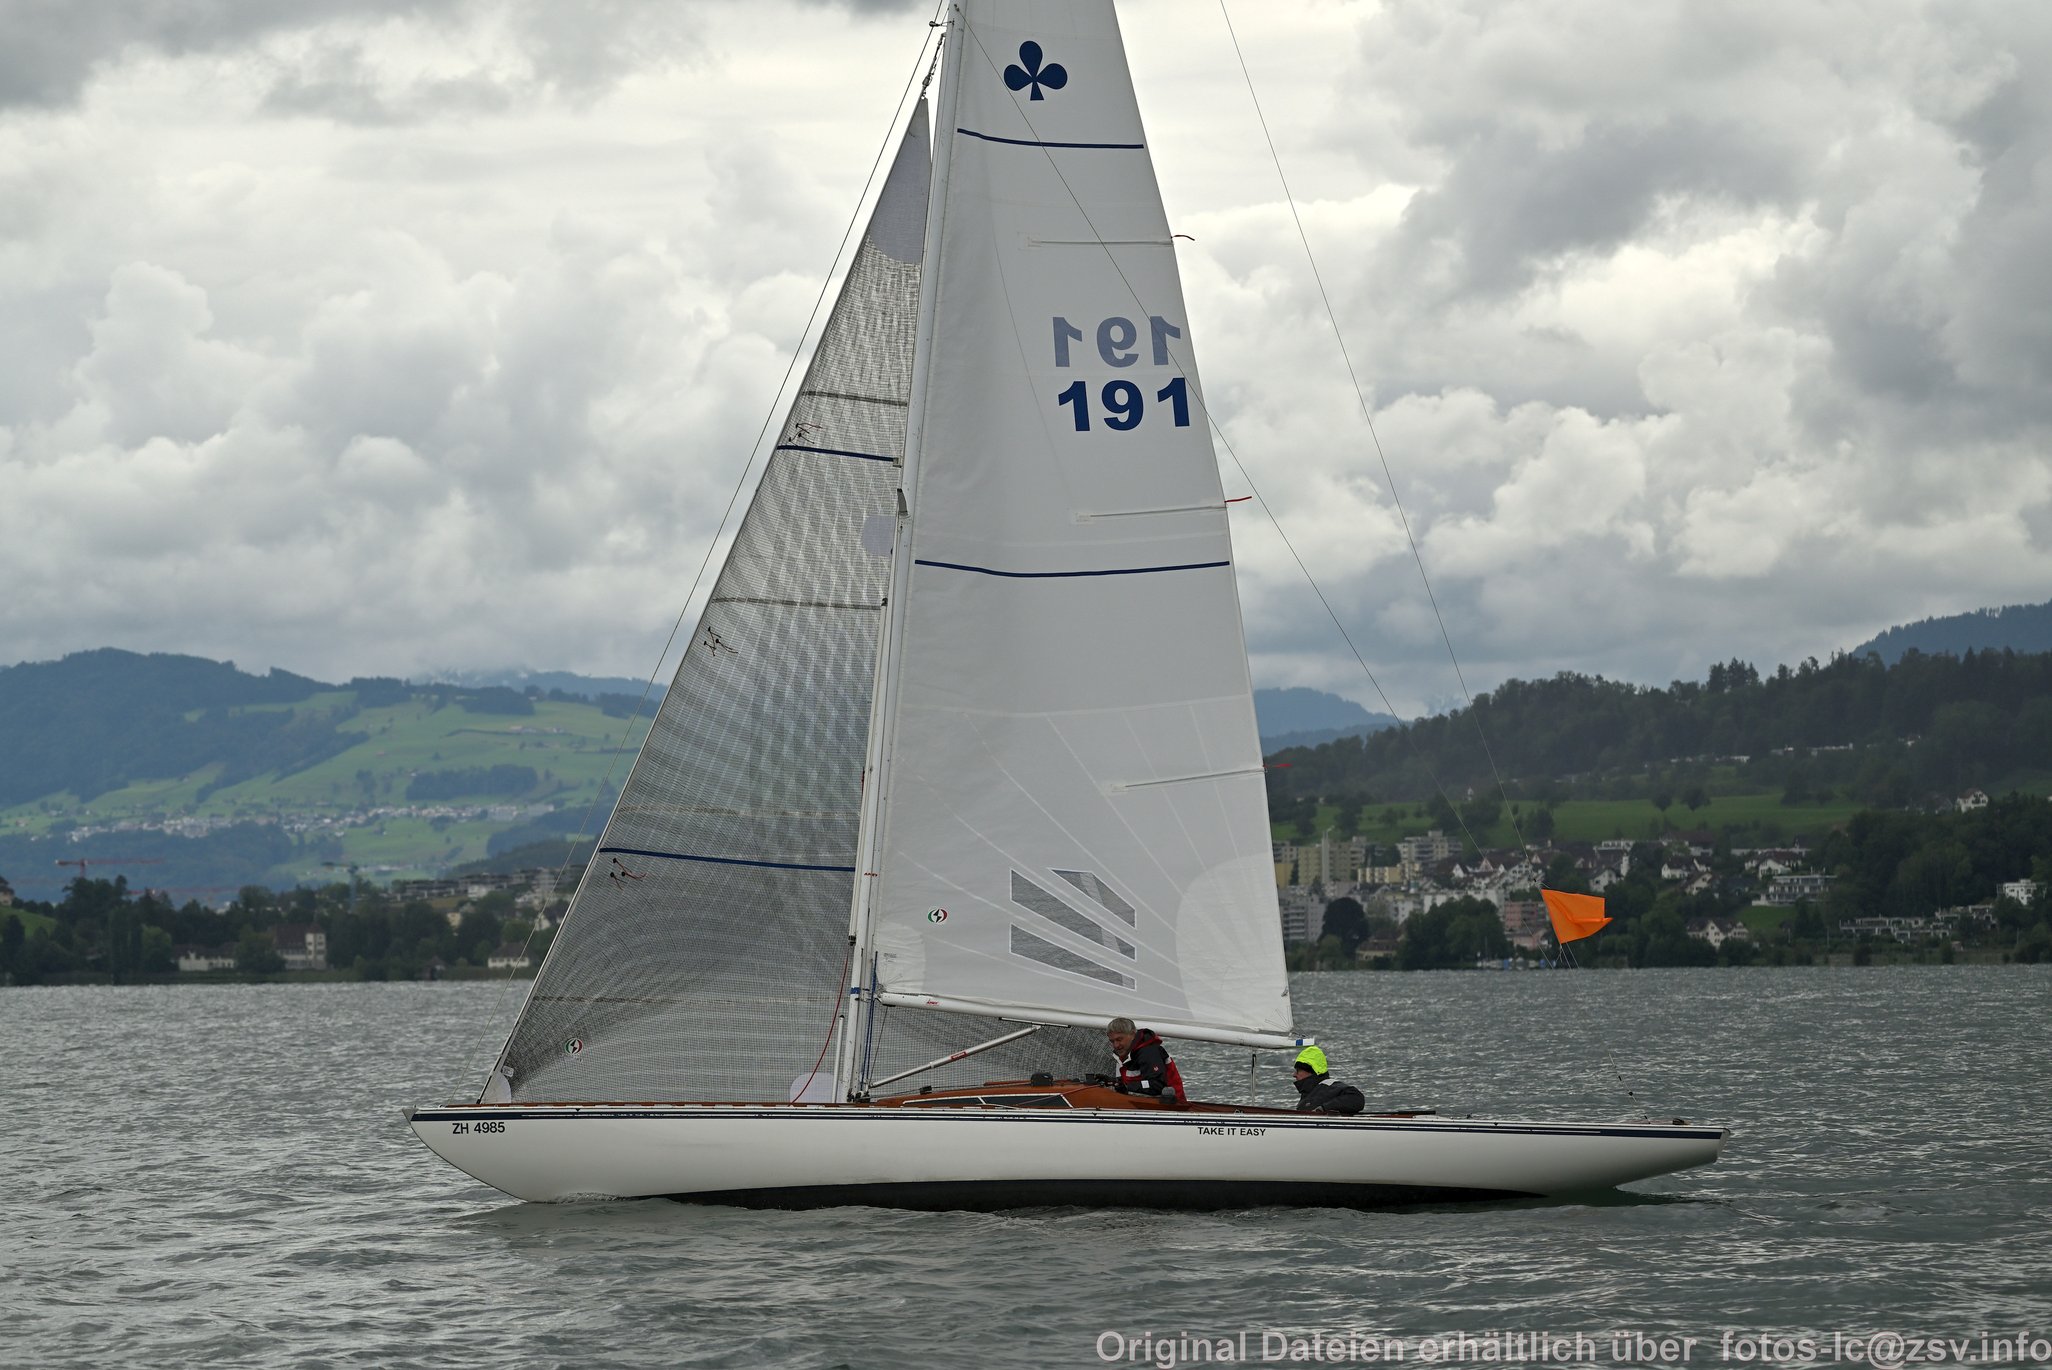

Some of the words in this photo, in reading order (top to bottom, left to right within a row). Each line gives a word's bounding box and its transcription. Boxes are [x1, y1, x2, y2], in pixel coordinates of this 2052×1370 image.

[1058, 377, 1190, 431] 191
[452, 1122, 469, 1134] ZH
[473, 1121, 506, 1134] 4985
[1198, 1126, 1225, 1136] TAKE
[1227, 1127, 1237, 1136] IT
[1240, 1128, 1266, 1136] EASY
